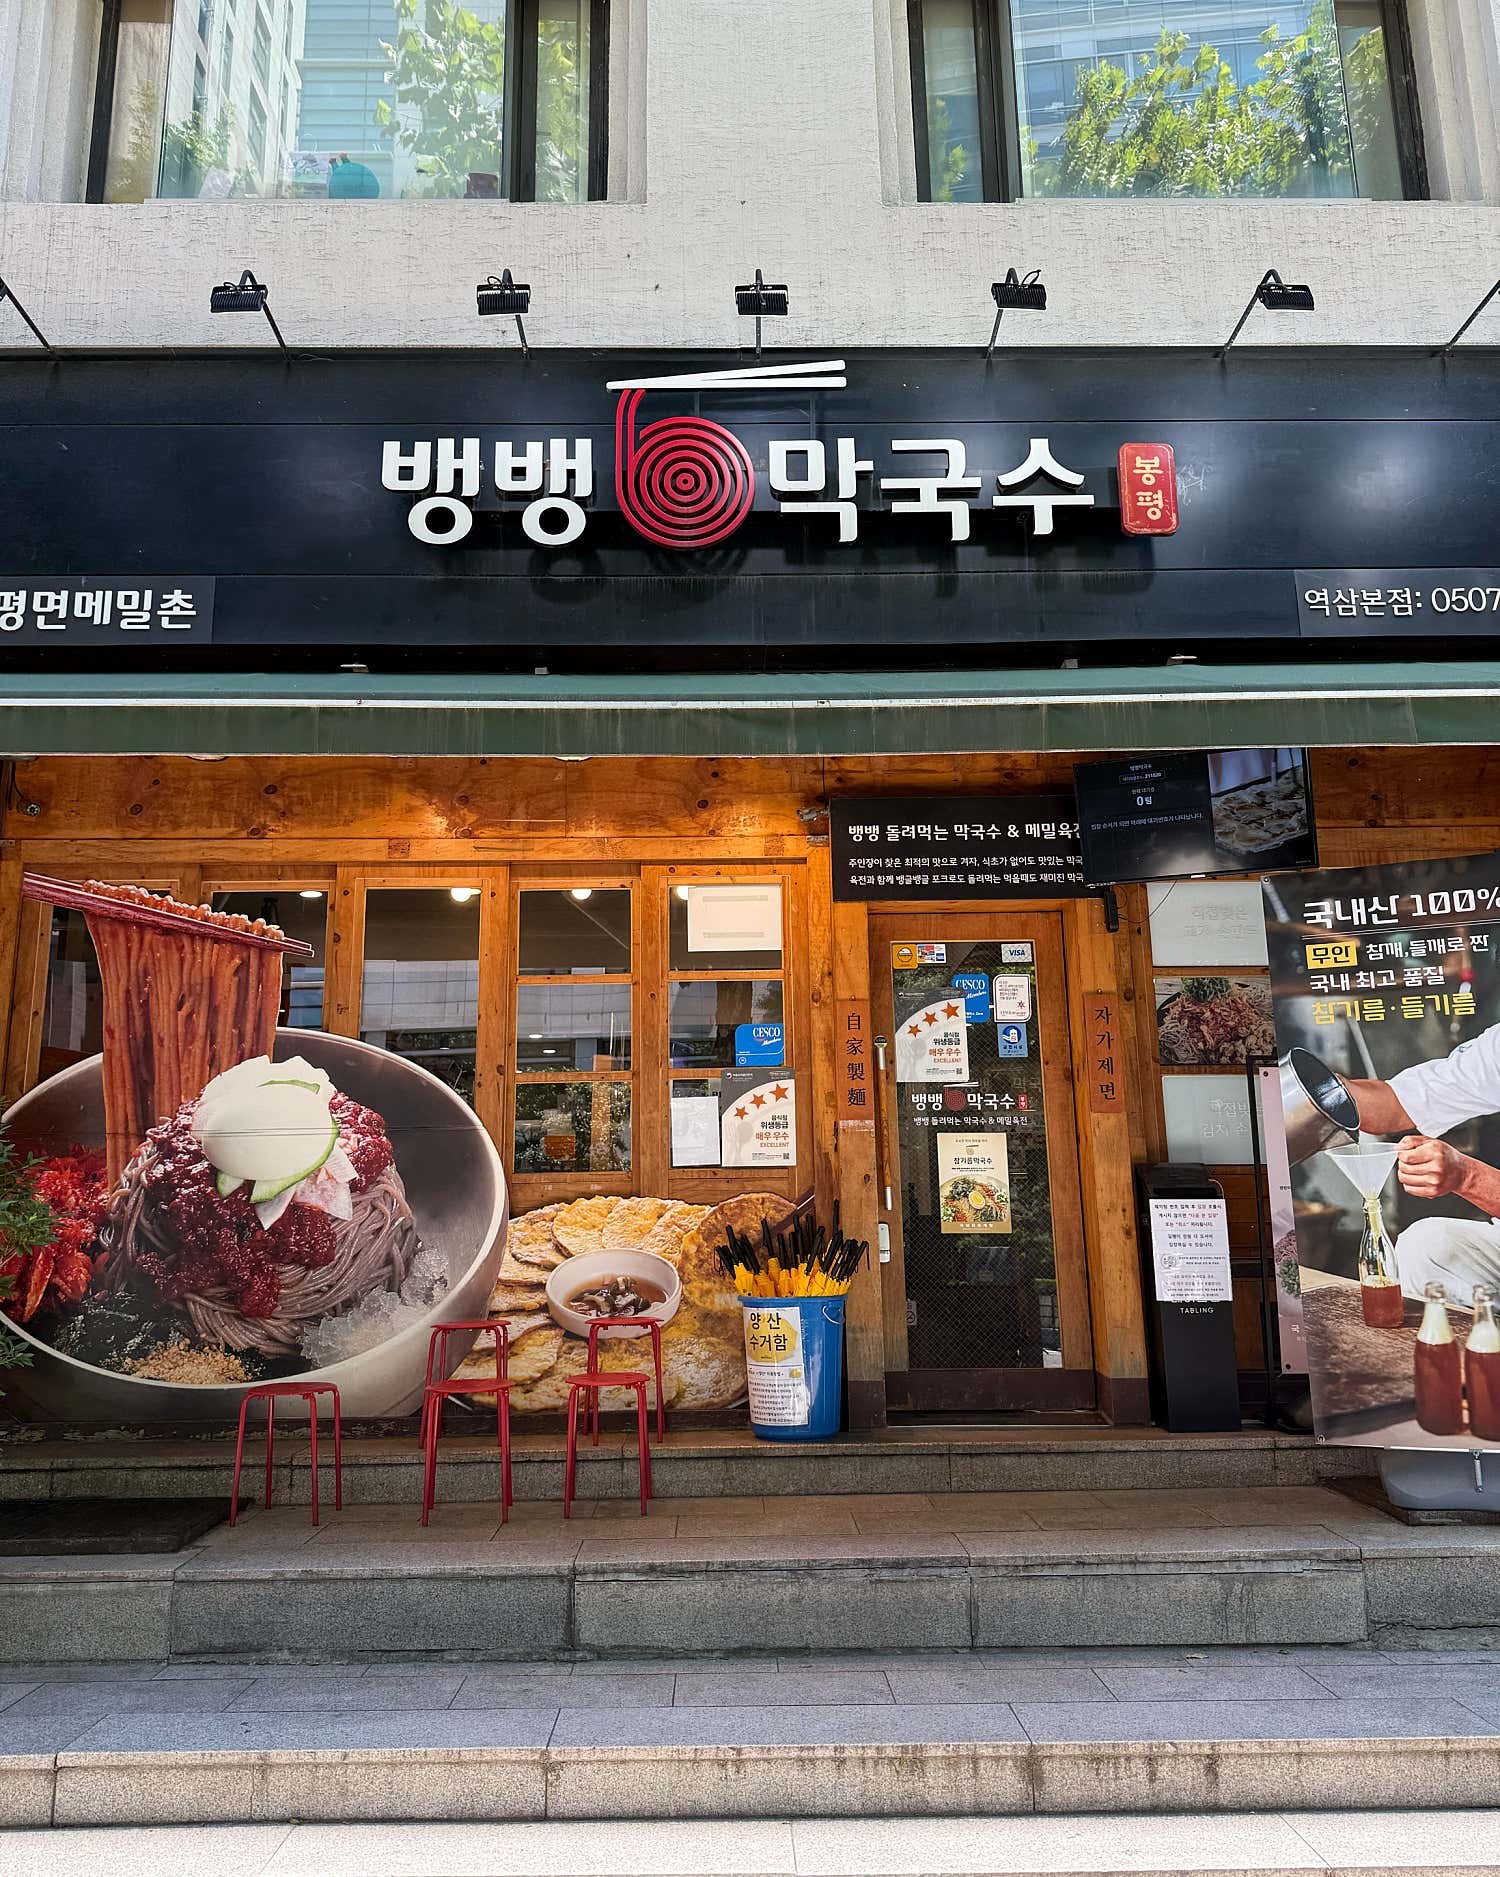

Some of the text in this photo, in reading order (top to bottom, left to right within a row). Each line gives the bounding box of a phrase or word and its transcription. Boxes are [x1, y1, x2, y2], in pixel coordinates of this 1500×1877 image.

[381, 438, 1095, 546] 뱅뱅 막국수
[1133, 456, 1164, 520] 봉평
[0, 589, 197, 631] 평면메밀촌
[1304, 587, 1500, 617] 역삼본점: 0507
[848, 825, 880, 842] 뱅뱅
[885, 825, 949, 842] 돌려먹는
[953, 824, 1002, 841] 막국수
[1007, 824, 1020, 838] &
[849, 858, 882, 868] 주인장이
[885, 858, 902, 868] 찾은
[904, 857, 930, 867] 최적의
[932, 857, 958, 867] 맛으로
[960, 857, 980, 867] 겨자,
[982, 856, 1007, 867] 식초가
[1009, 856, 1036, 867] 없어도
[1038, 855, 1064, 866] 맛있는
[850, 875, 875, 885] 육전과
[877, 875, 894, 885] 함께
[896, 874, 929, 885] 뱅글뱅글
[932, 874, 966, 883] 포크로도
[1040, 872, 1065, 883] 재미진
[1303, 886, 1500, 929] 국내산 100%
[1469, 934, 1490, 952] 짠
[956, 979, 985, 990] CESCO
[1309, 966, 1445, 993] 국내 최고 품질
[753, 1027, 781, 1037] CESCO
[933, 1037, 961, 1046] 위생등급
[946, 1048, 961, 1056] 우수
[1095, 1006, 1117, 1101] 자가제면
[911, 1093, 1016, 1111] 뱅뱅 막국수
[760, 1121, 788, 1130] 위생등급
[914, 1116, 1028, 1126] 뱅뱅 돌려먹는 막국수 & 메밀육전
[756, 1131, 789, 1141] 매우 우수
[750, 1334, 788, 1351] 수거함
